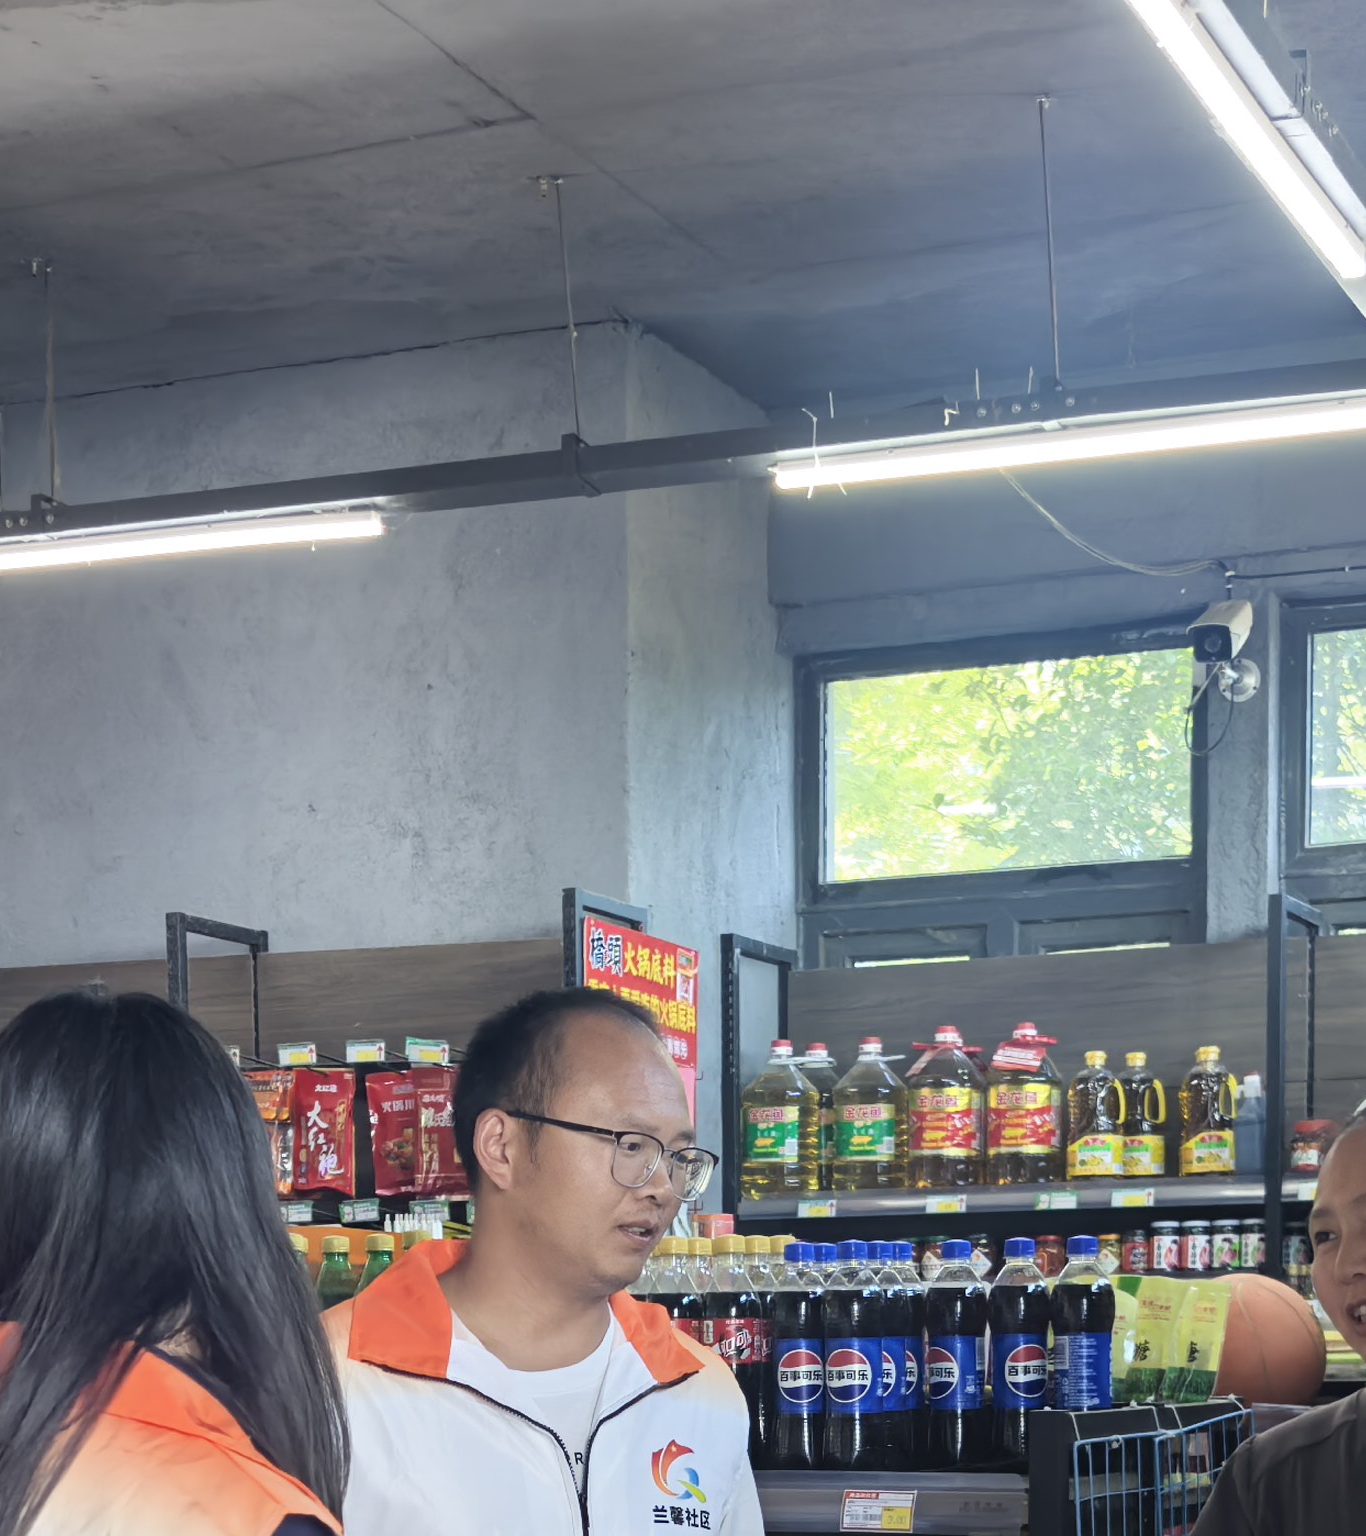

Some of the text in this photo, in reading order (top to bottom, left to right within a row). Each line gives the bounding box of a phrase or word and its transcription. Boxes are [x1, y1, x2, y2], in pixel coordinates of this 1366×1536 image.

[624, 942, 676, 989] 火锅底料
[918, 1095, 959, 1108] 金龙鱼
[996, 1090, 1038, 1105] 金龙鱼
[750, 1106, 784, 1121] 金龙鱼
[845, 1106, 881, 1120] 金龙鱼
[306, 1100, 345, 1178] 大红袍
[780, 1370, 823, 1382] 百事可乐
[827, 1370, 869, 1382] 百事可乐
[652, 1504, 712, 1530] 兰馨社区
[887, 1515, 907, 1525] 3.00
